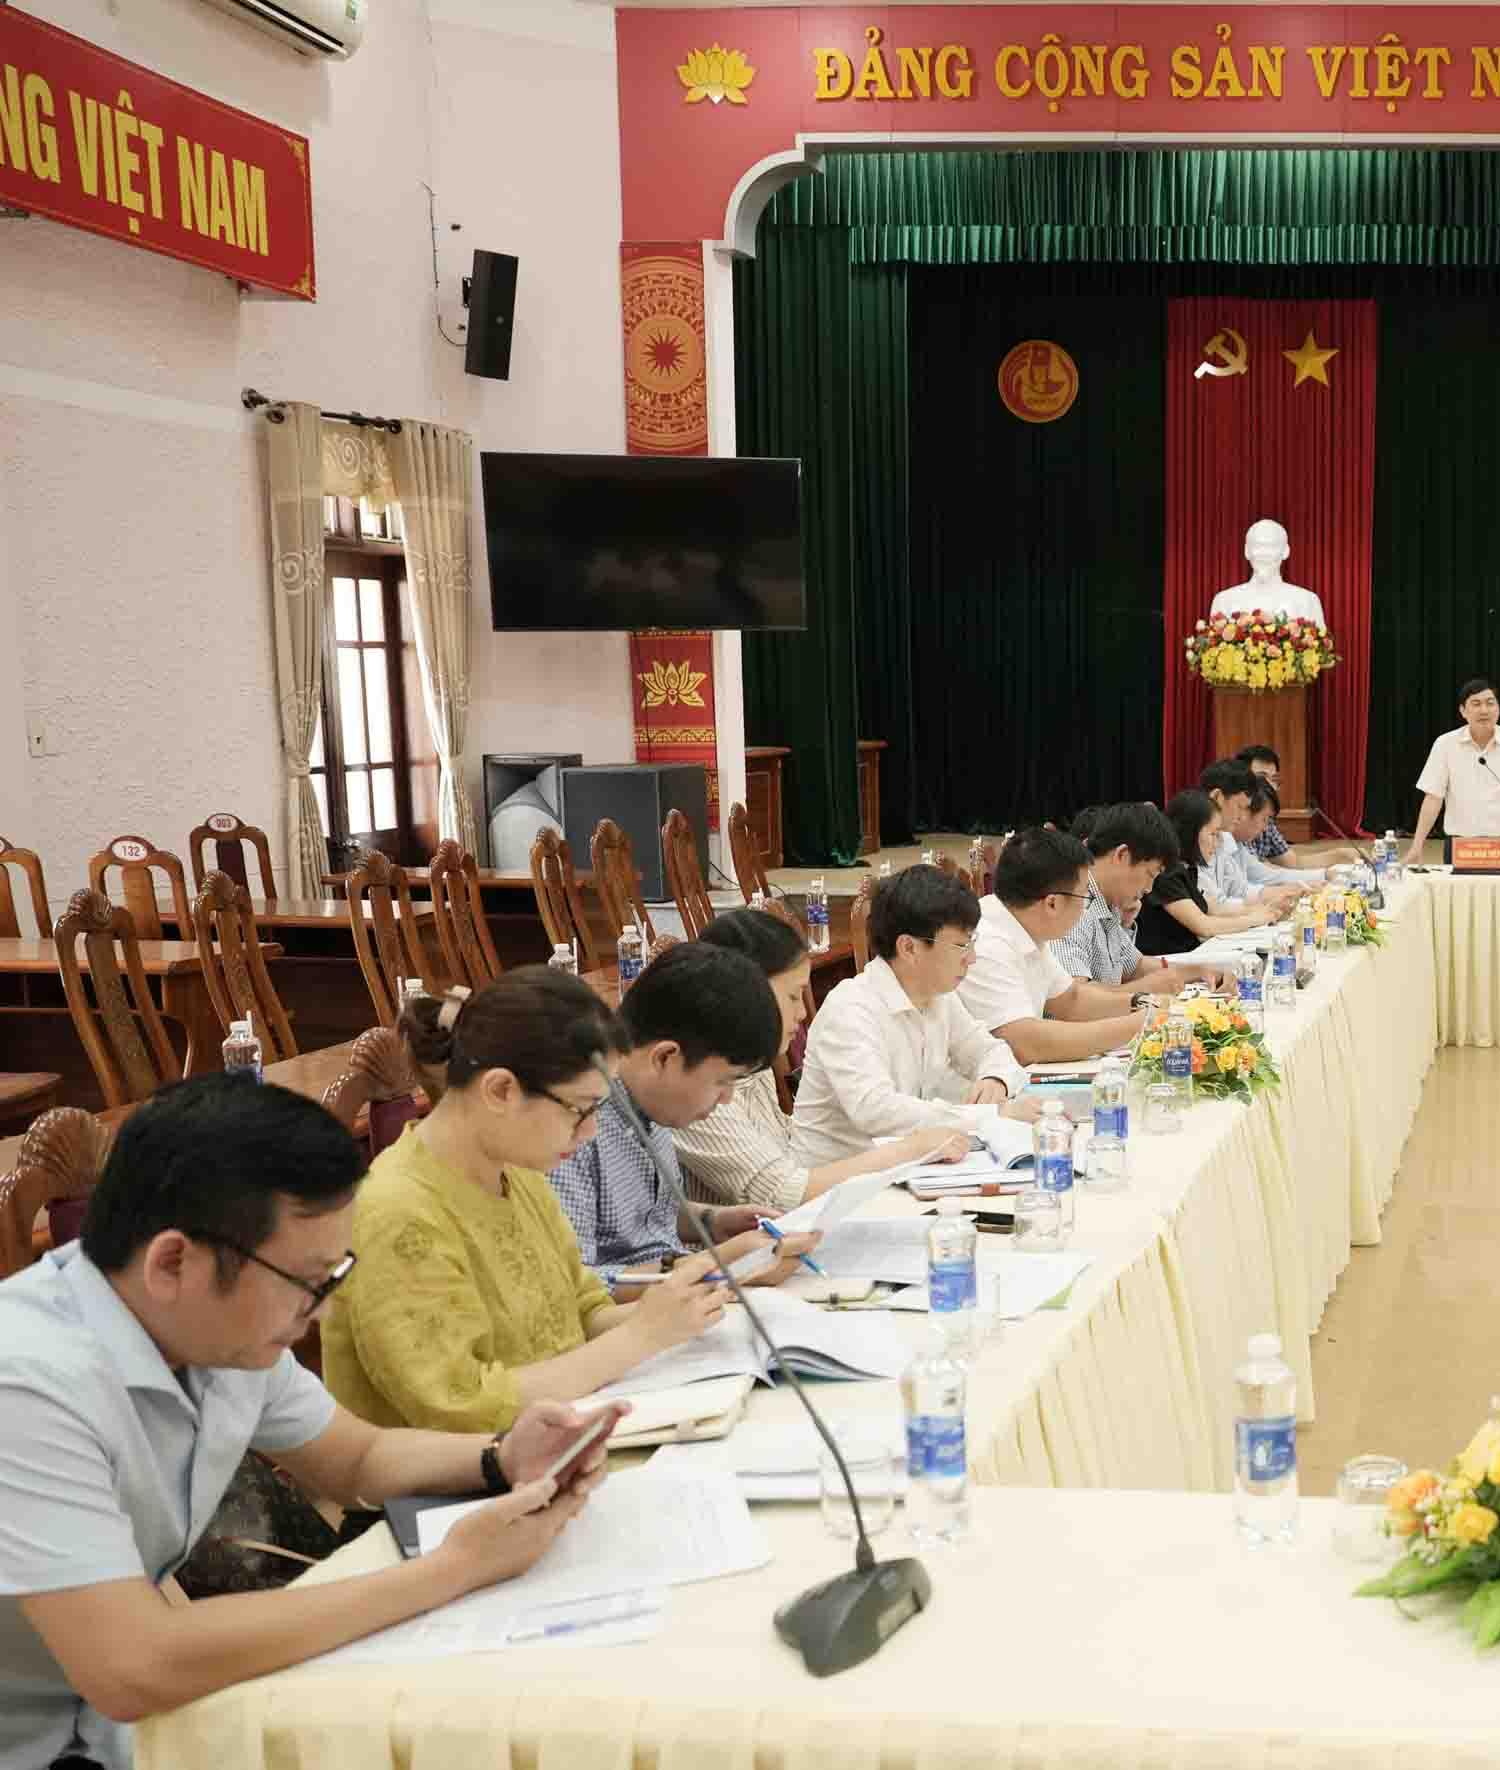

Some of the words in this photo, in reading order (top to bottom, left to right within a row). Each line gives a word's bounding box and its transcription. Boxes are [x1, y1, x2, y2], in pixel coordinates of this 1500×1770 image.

[813, 25, 974, 99] ĐẢNG
[995, 33, 1149, 113] CỘNG
[1170, 24, 1286, 98] SẢN
[1306, 33, 1452, 113] VIỆT
[69, 88, 164, 234] VIỆT
[176, 135, 270, 257] NAM
[121, 845, 141, 857] 132
